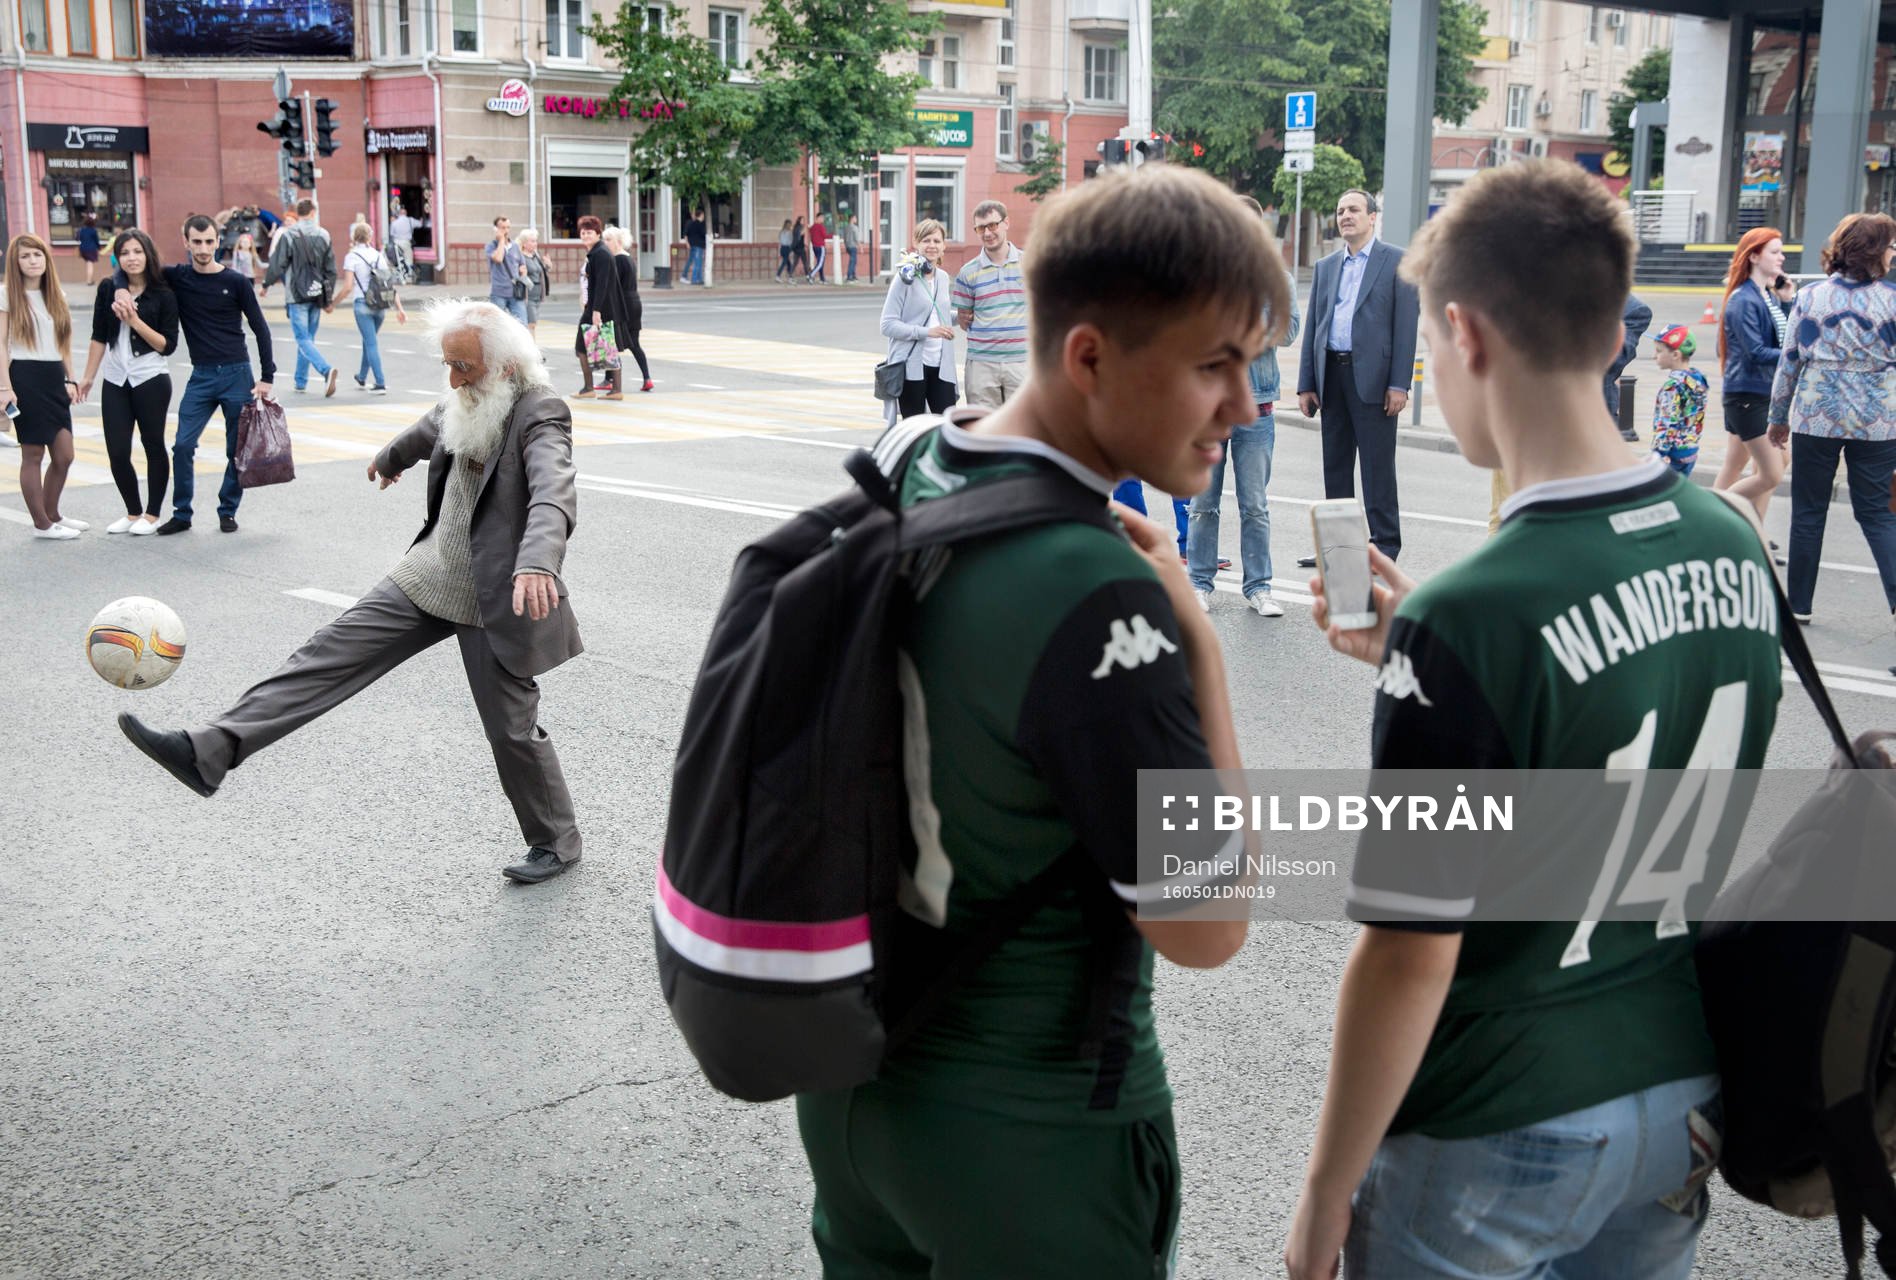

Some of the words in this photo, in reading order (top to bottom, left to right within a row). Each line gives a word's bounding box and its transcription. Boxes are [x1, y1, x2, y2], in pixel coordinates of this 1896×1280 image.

[488, 98, 523, 110] omni
[1540, 557, 1777, 685] WANDERSON
[1559, 681, 1748, 968] 14
